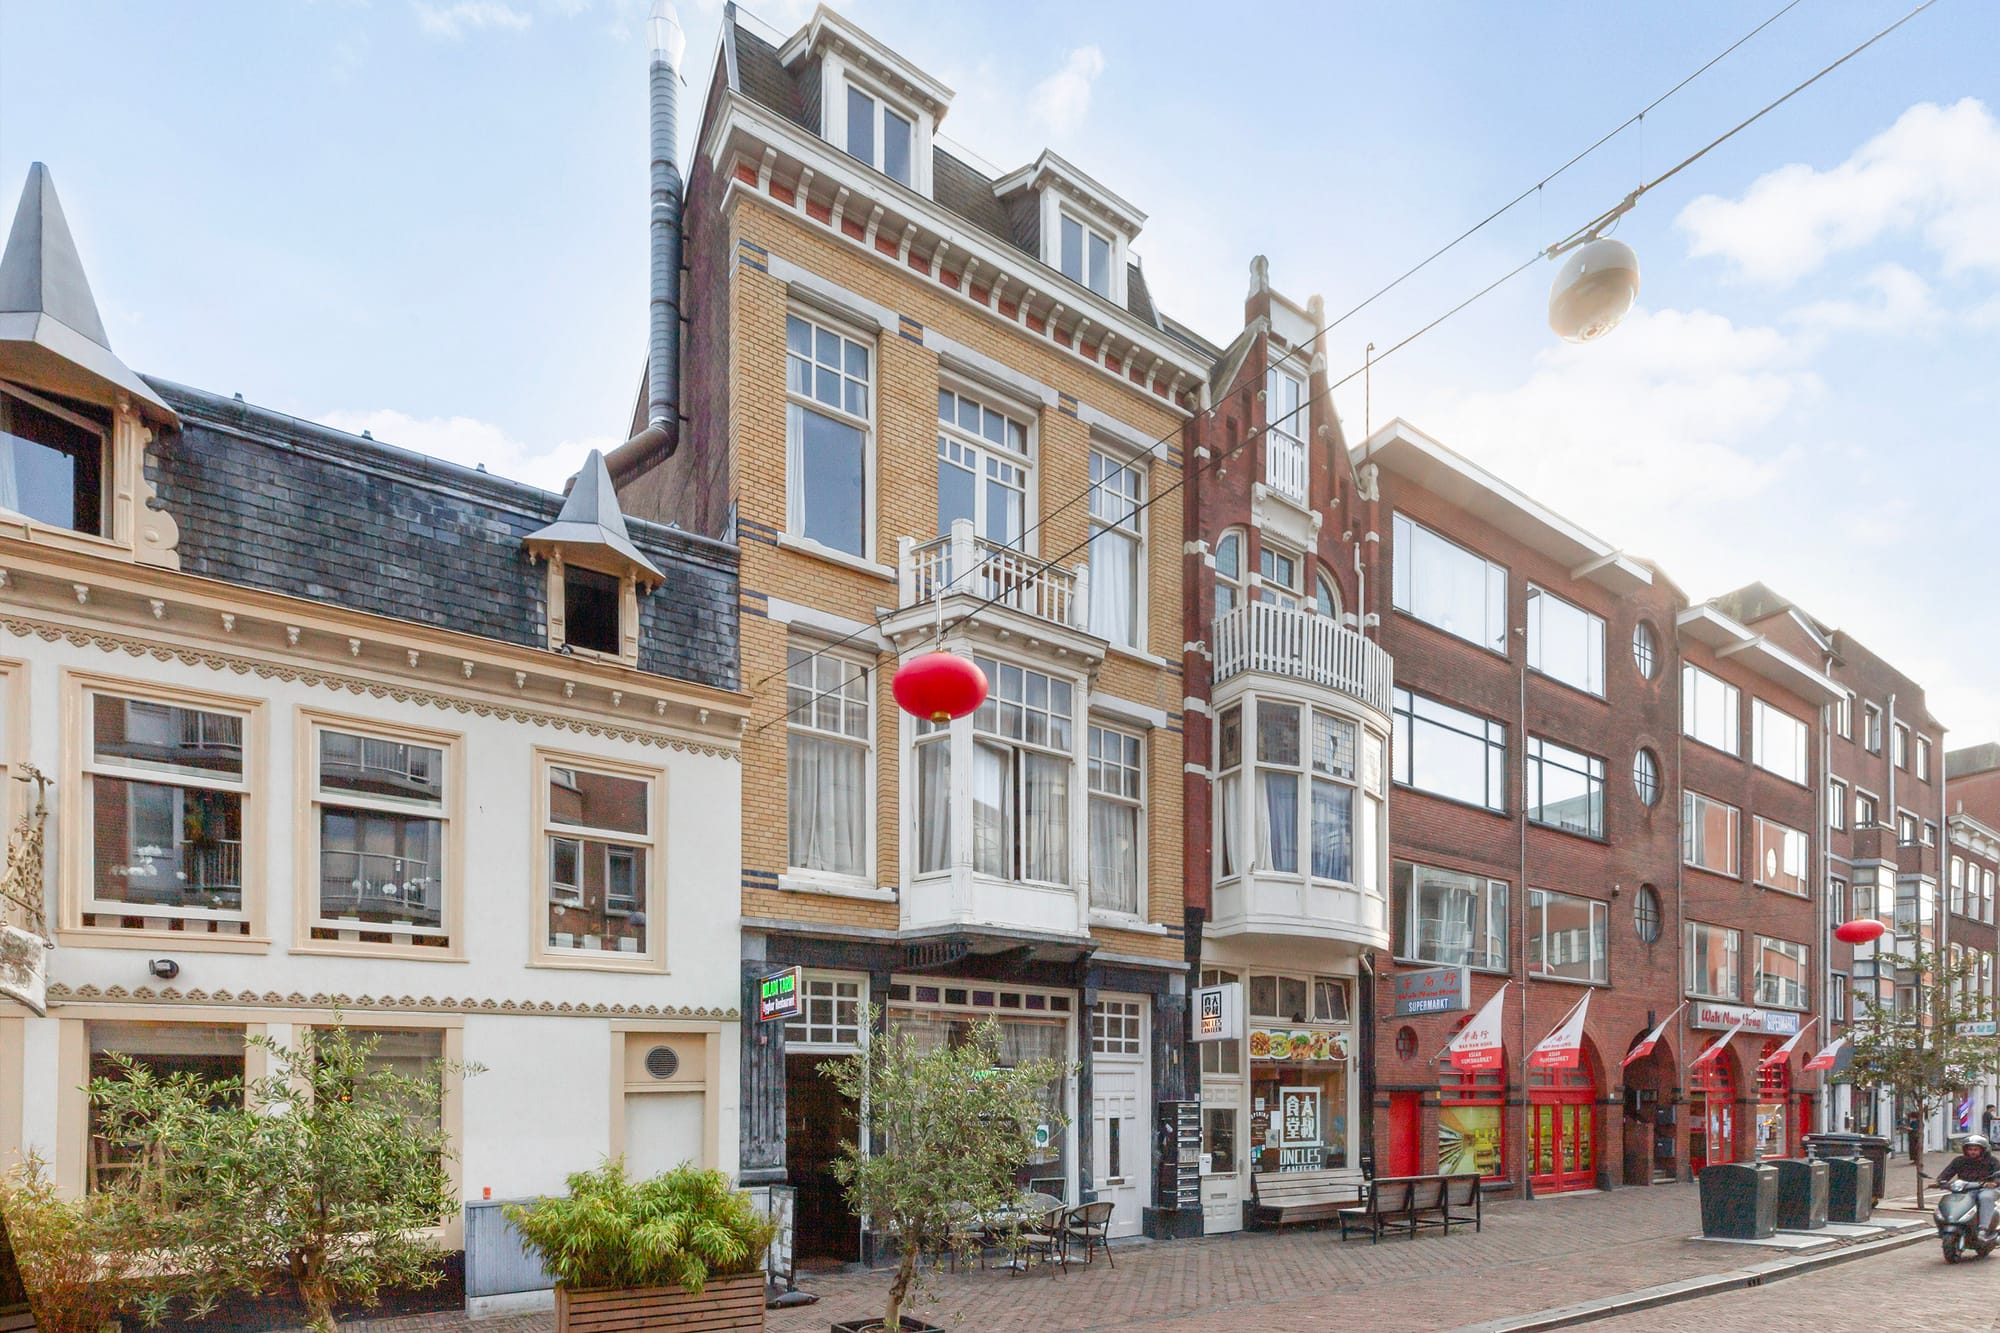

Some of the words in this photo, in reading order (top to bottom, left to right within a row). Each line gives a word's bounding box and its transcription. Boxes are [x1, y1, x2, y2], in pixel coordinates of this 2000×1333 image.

[1408, 998, 1448, 1012] SUPERMARKT
[1701, 1009, 1720, 1023] Wah
[1280, 1147, 1321, 1165] UNCLES
